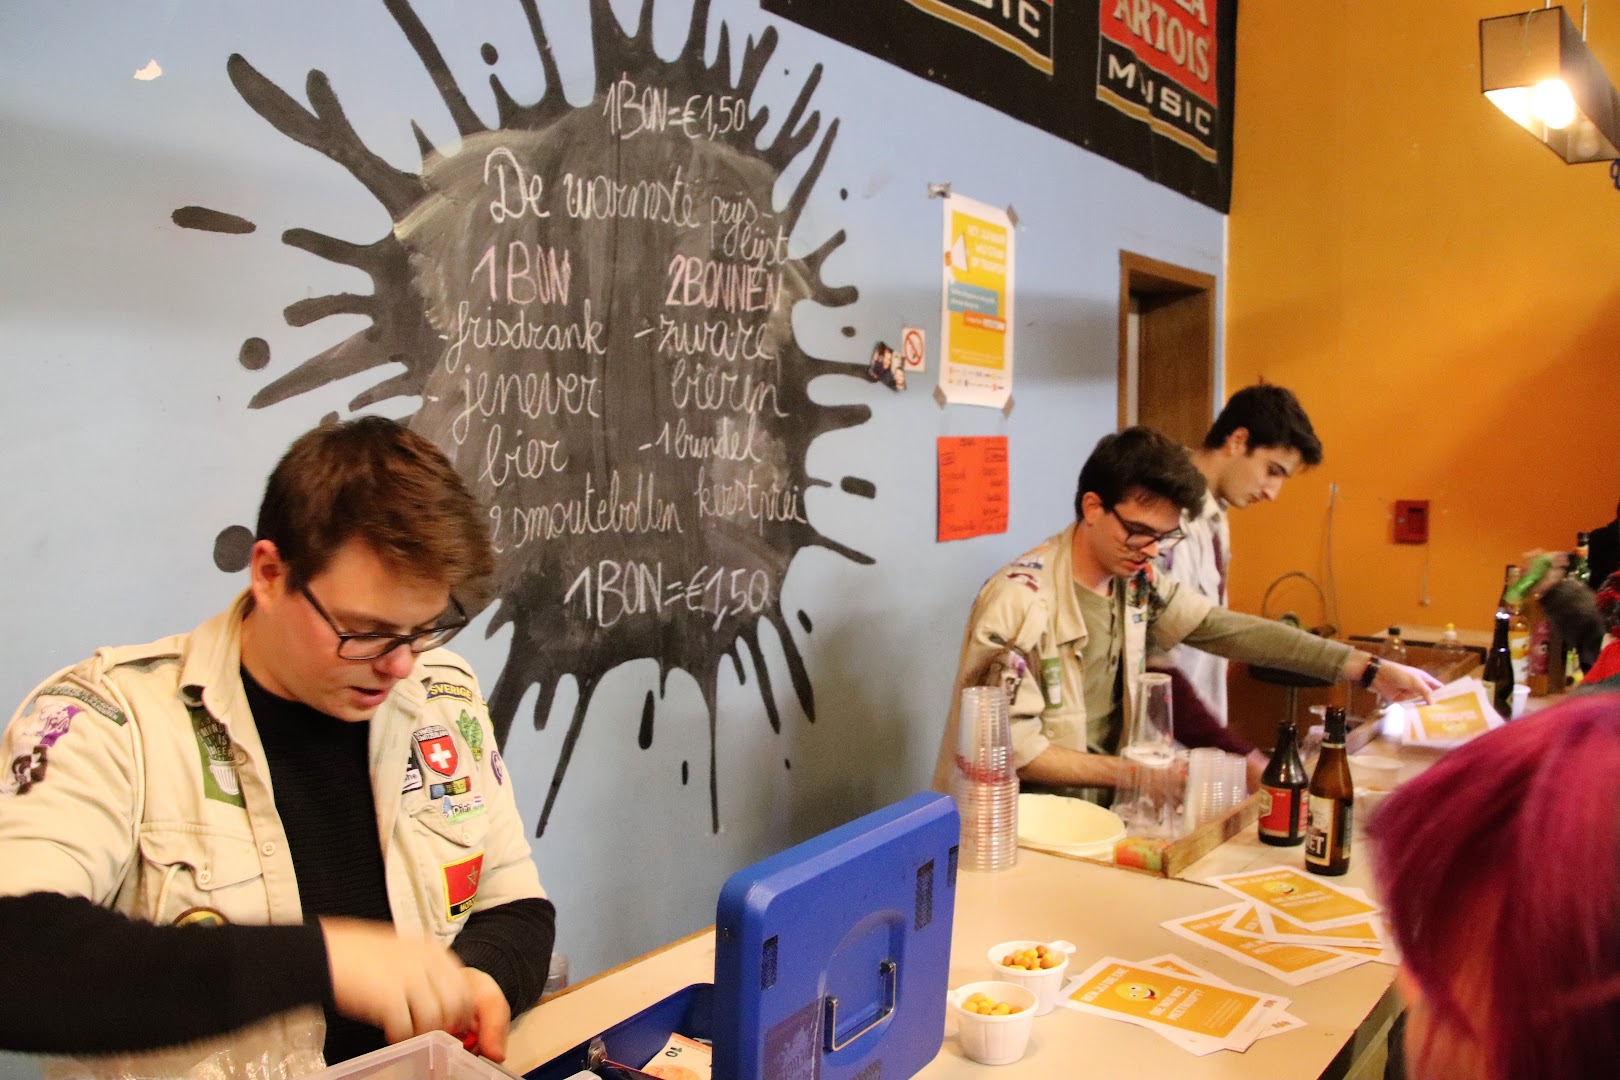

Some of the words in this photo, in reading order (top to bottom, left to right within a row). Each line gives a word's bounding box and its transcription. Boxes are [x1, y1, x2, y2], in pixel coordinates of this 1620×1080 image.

[484, 146, 550, 224] De
[563, 165, 700, 228] warmste
[478, 424, 569, 487] bier
[513, 469, 684, 548] smoutebollen
[429, 684, 472, 699] SVERIGE
[665, 1046, 682, 1058] 10
